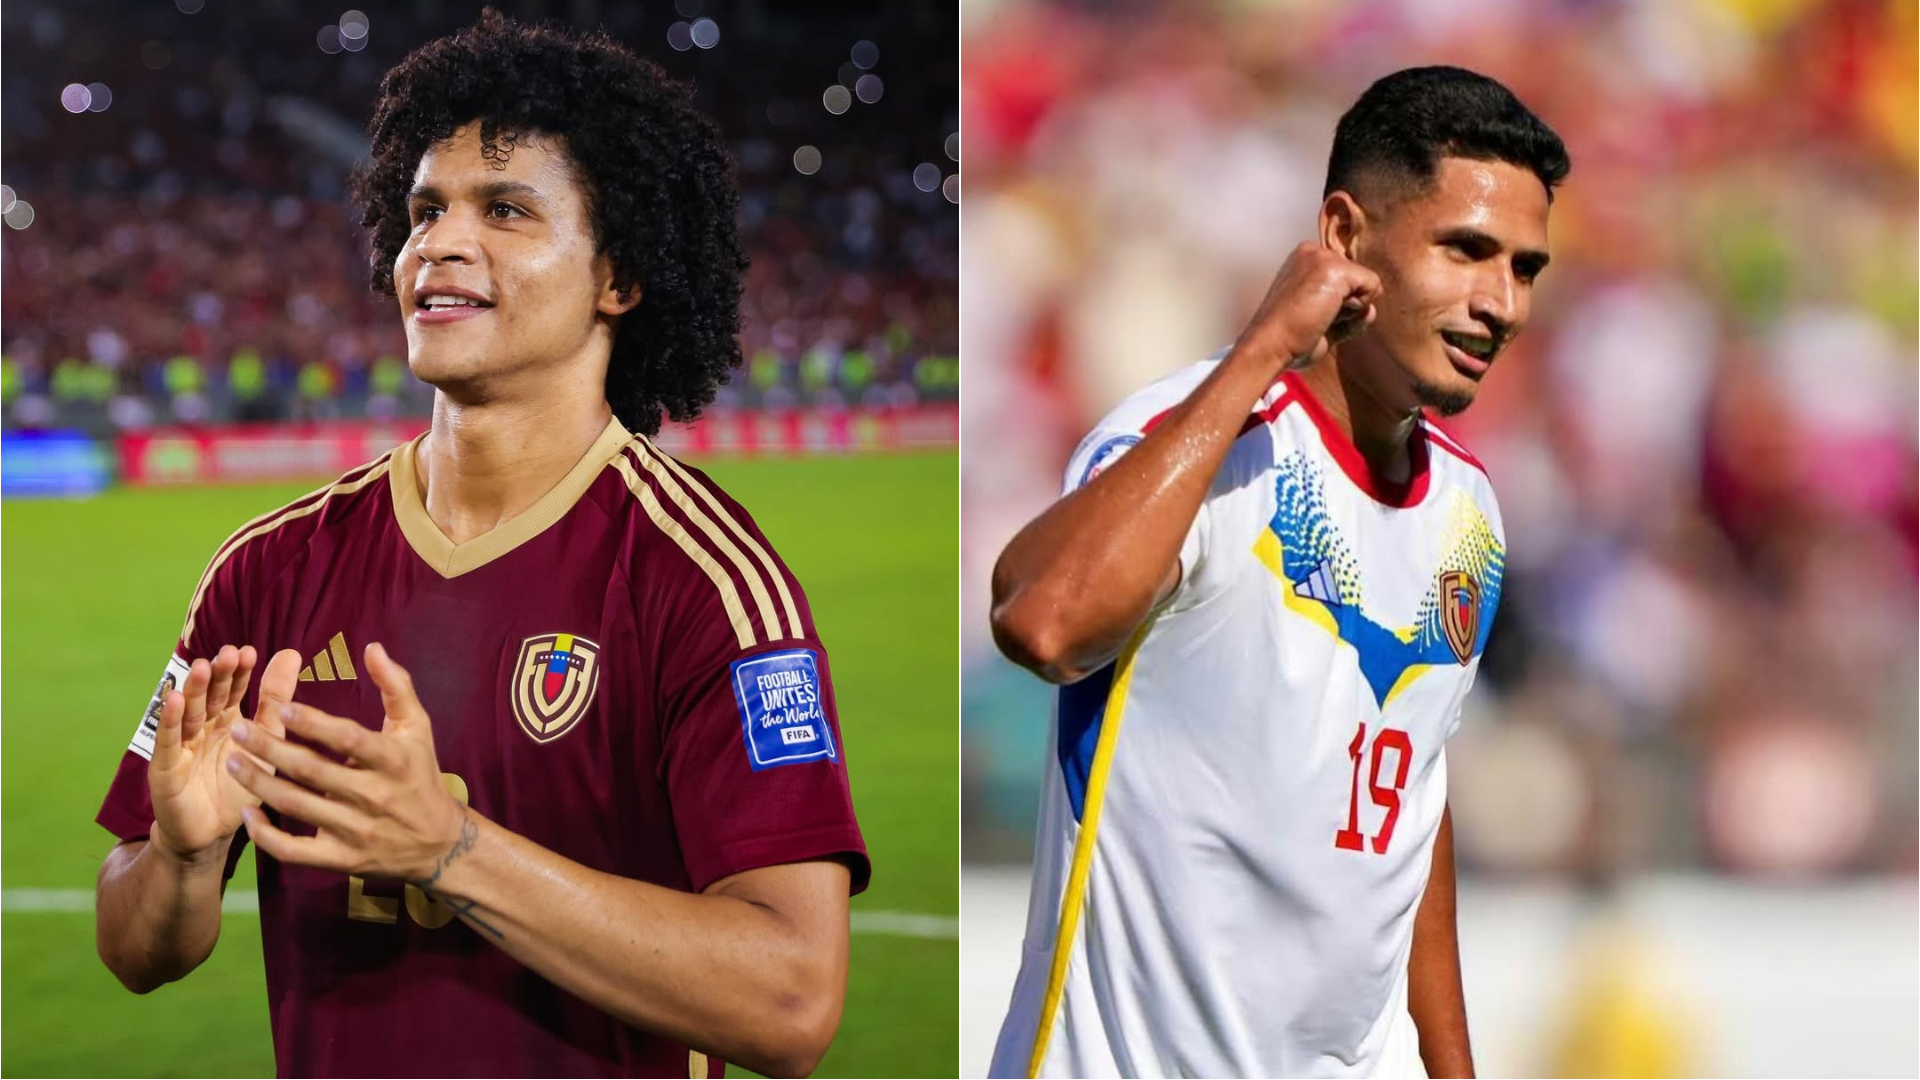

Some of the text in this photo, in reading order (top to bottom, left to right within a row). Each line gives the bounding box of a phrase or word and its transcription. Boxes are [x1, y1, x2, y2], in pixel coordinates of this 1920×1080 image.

[756, 669, 812, 691] FOOTBALL
[761, 683, 817, 711] UNITES
[760, 711, 784, 728] the
[786, 729, 811, 740] FIFA
[1335, 721, 1413, 855] 19
